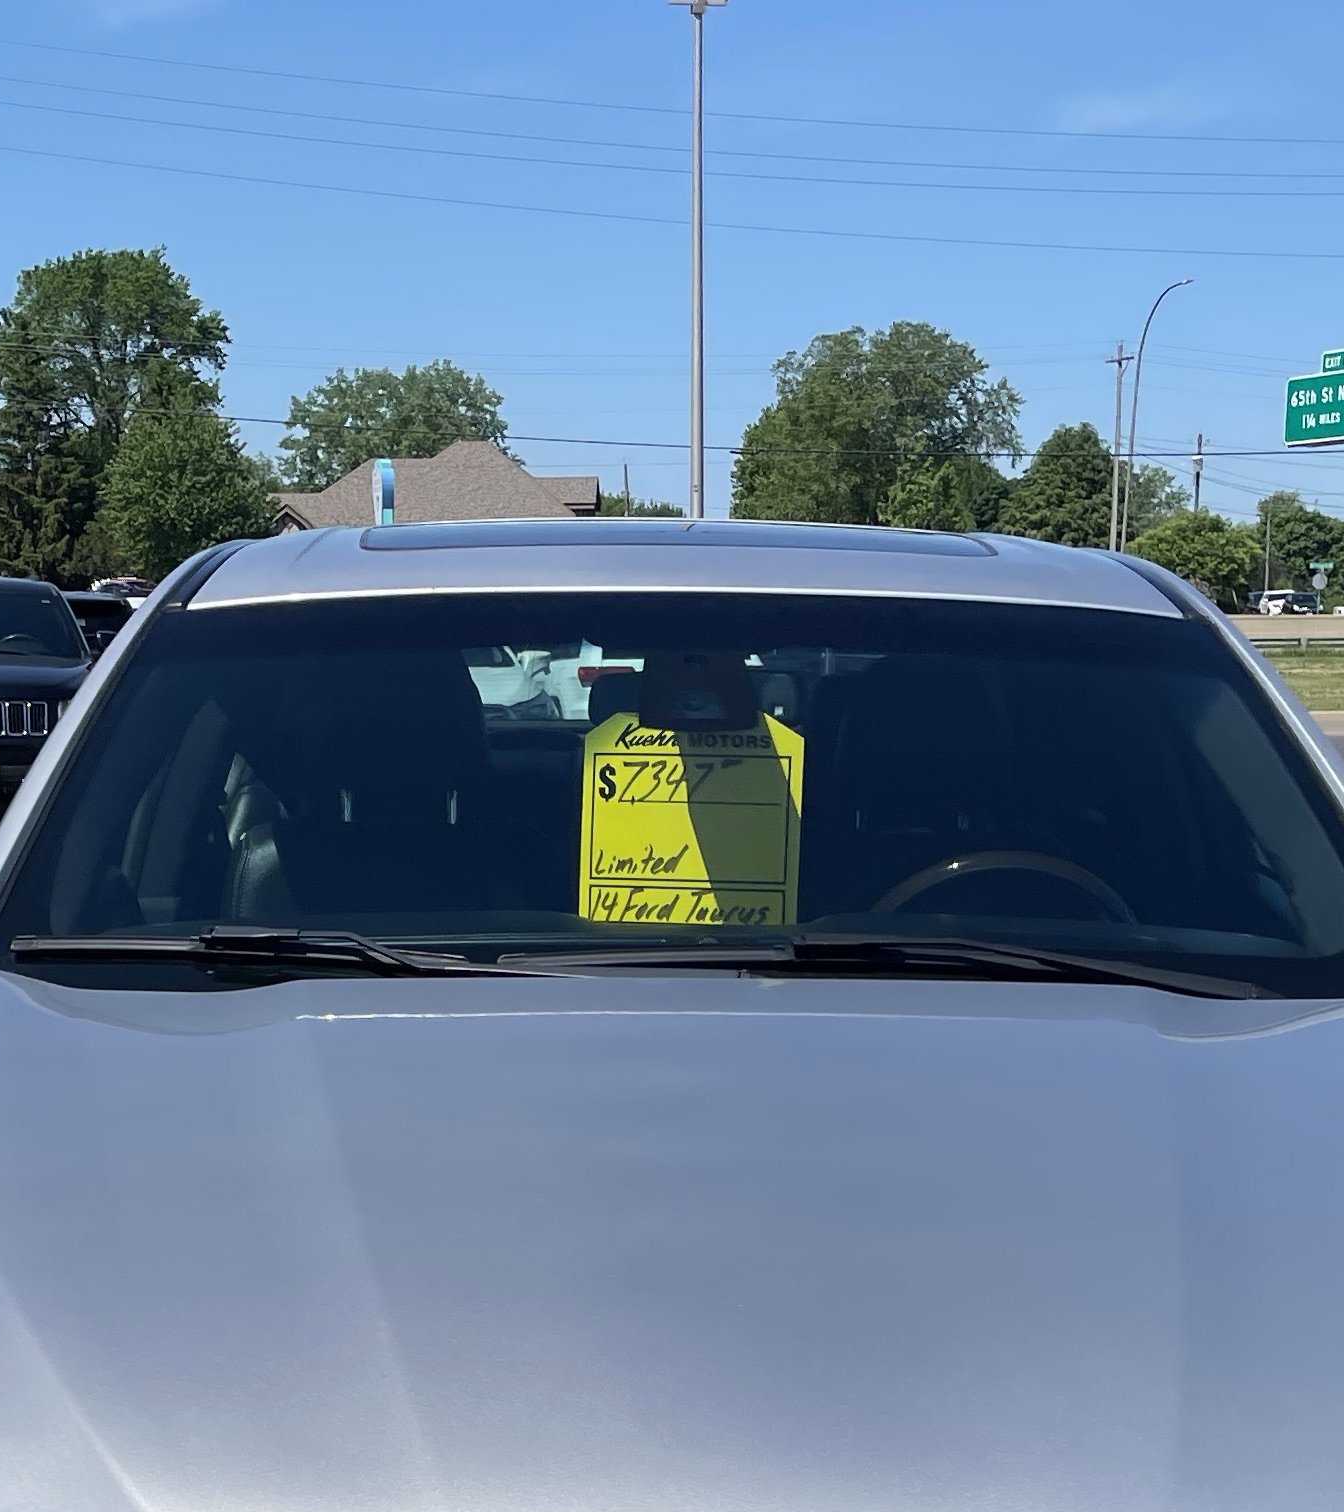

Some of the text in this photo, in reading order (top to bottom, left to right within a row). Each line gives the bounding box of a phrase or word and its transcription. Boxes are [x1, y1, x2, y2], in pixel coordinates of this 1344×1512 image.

[1324, 355, 1342, 369] EXIT
[1290, 389, 1316, 408] 65th
[1321, 386, 1334, 404] St
[1319, 411, 1341, 425] MILES
[614, 721, 772, 750] Kuehn MOTORS
[593, 844, 689, 876] Limited
[590, 887, 771, 923] 14 Ford Taurus
